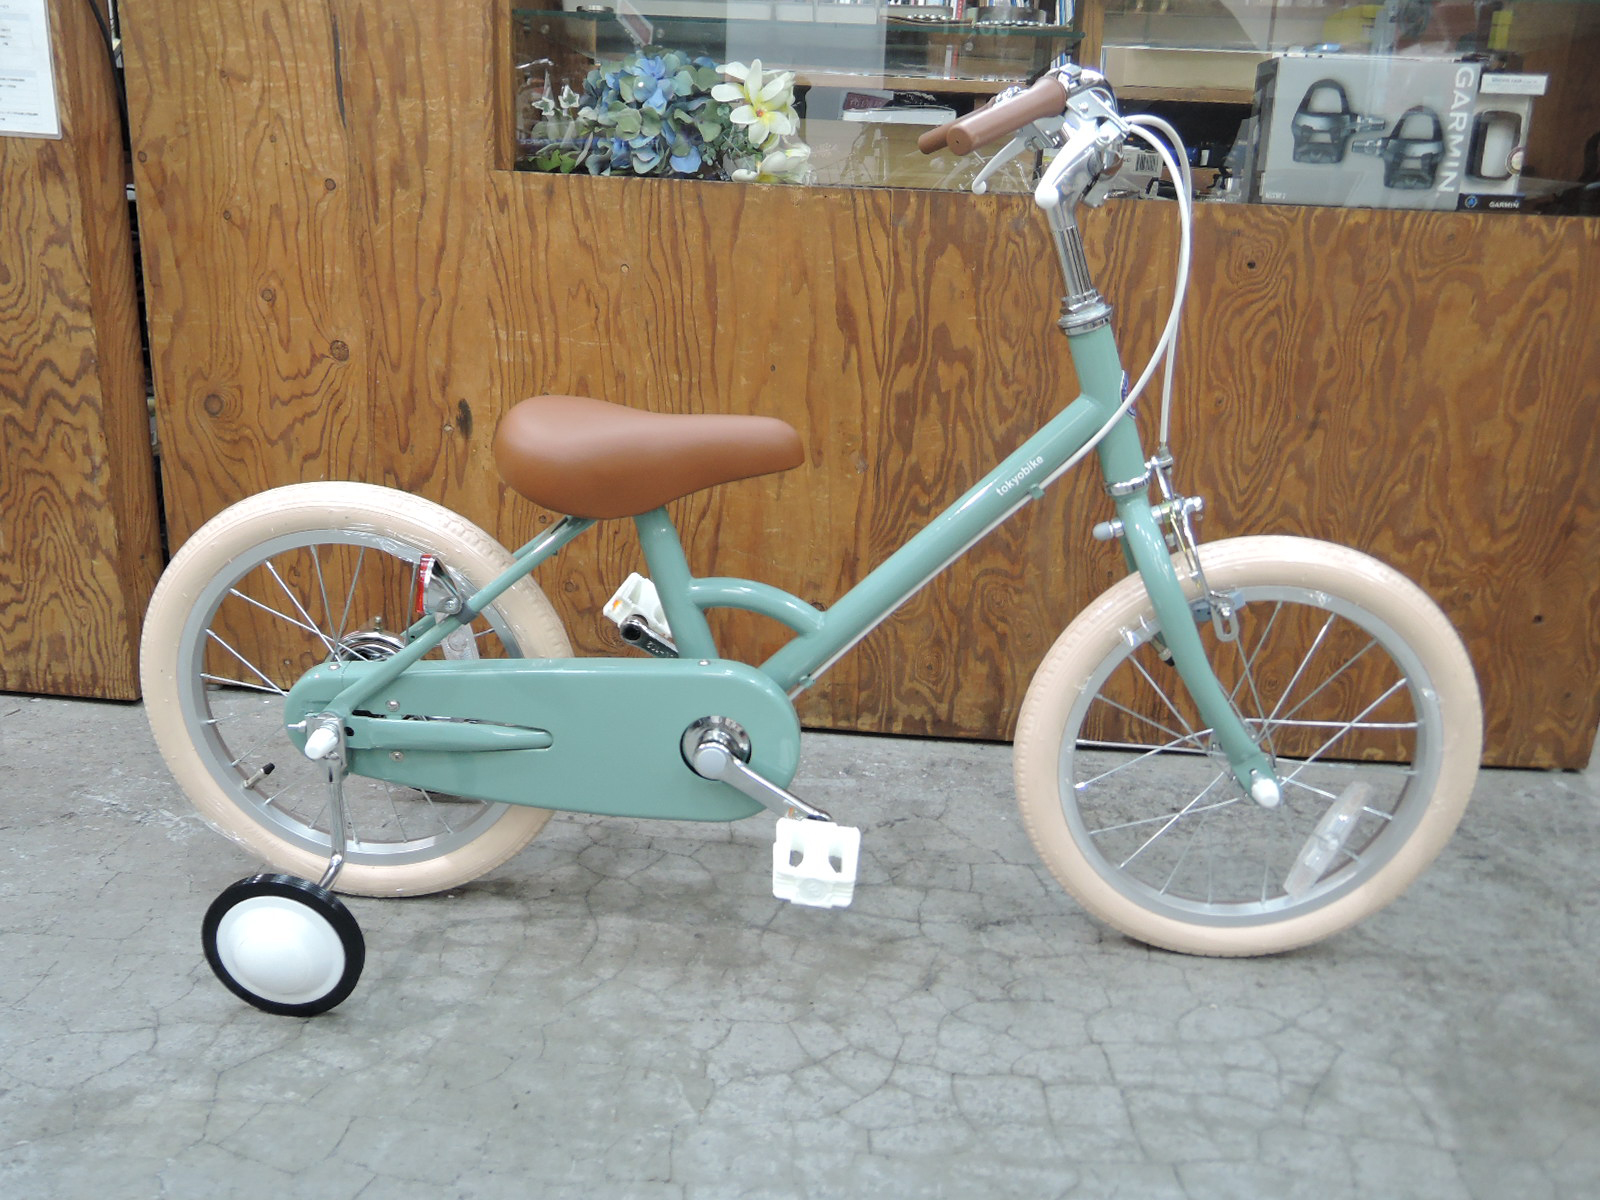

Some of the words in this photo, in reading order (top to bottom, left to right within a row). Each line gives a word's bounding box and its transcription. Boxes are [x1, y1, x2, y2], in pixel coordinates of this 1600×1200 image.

[1437, 66, 1474, 192] GARMIN
[1489, 200, 1519, 208] GARMIN
[996, 456, 1043, 496] tokyobike
